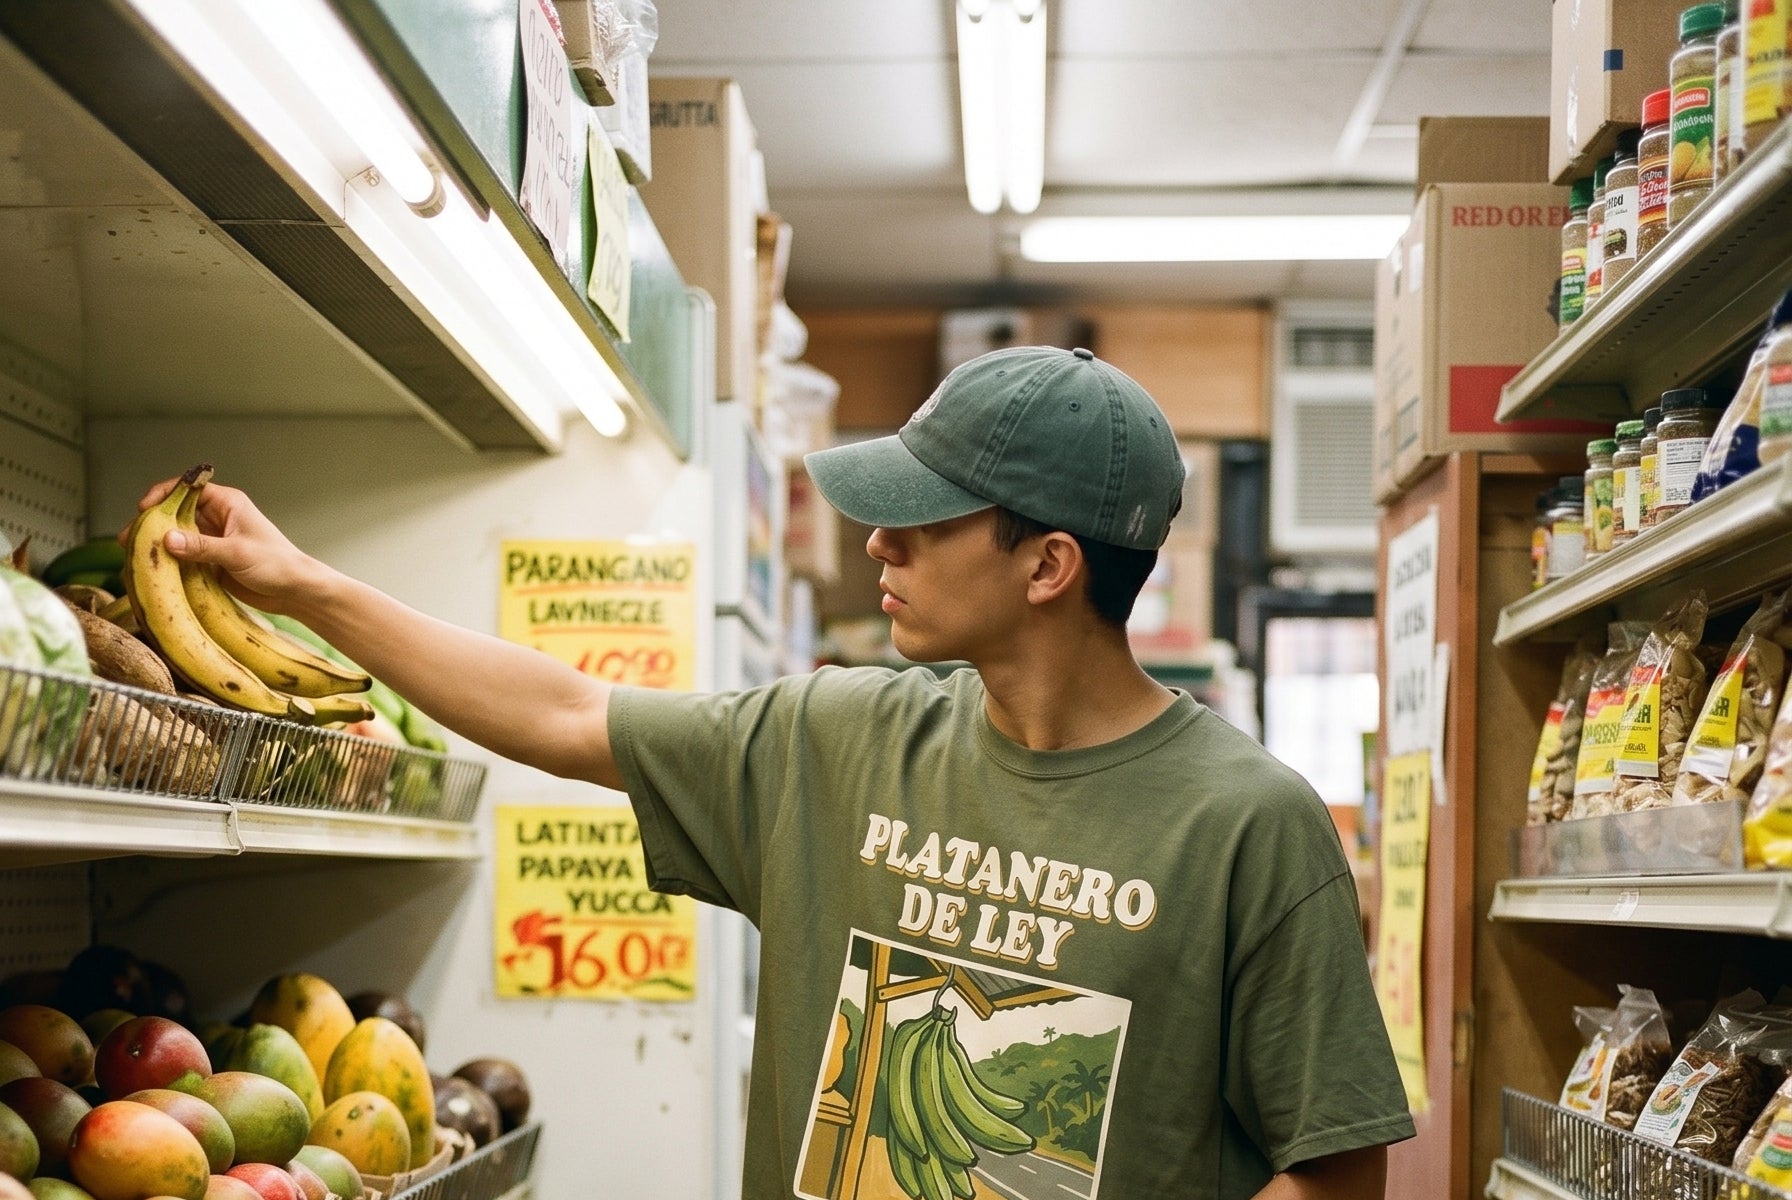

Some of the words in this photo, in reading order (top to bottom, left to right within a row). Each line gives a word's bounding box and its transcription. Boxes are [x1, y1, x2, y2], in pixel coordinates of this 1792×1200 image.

[1452, 205, 1503, 228] RED
[519, 856, 632, 880] PAPAYA
[860, 813, 1157, 932] PLATANERO
[566, 889, 672, 914] YUCCA
[898, 883, 967, 948] DE
[970, 904, 1075, 971] LEY
